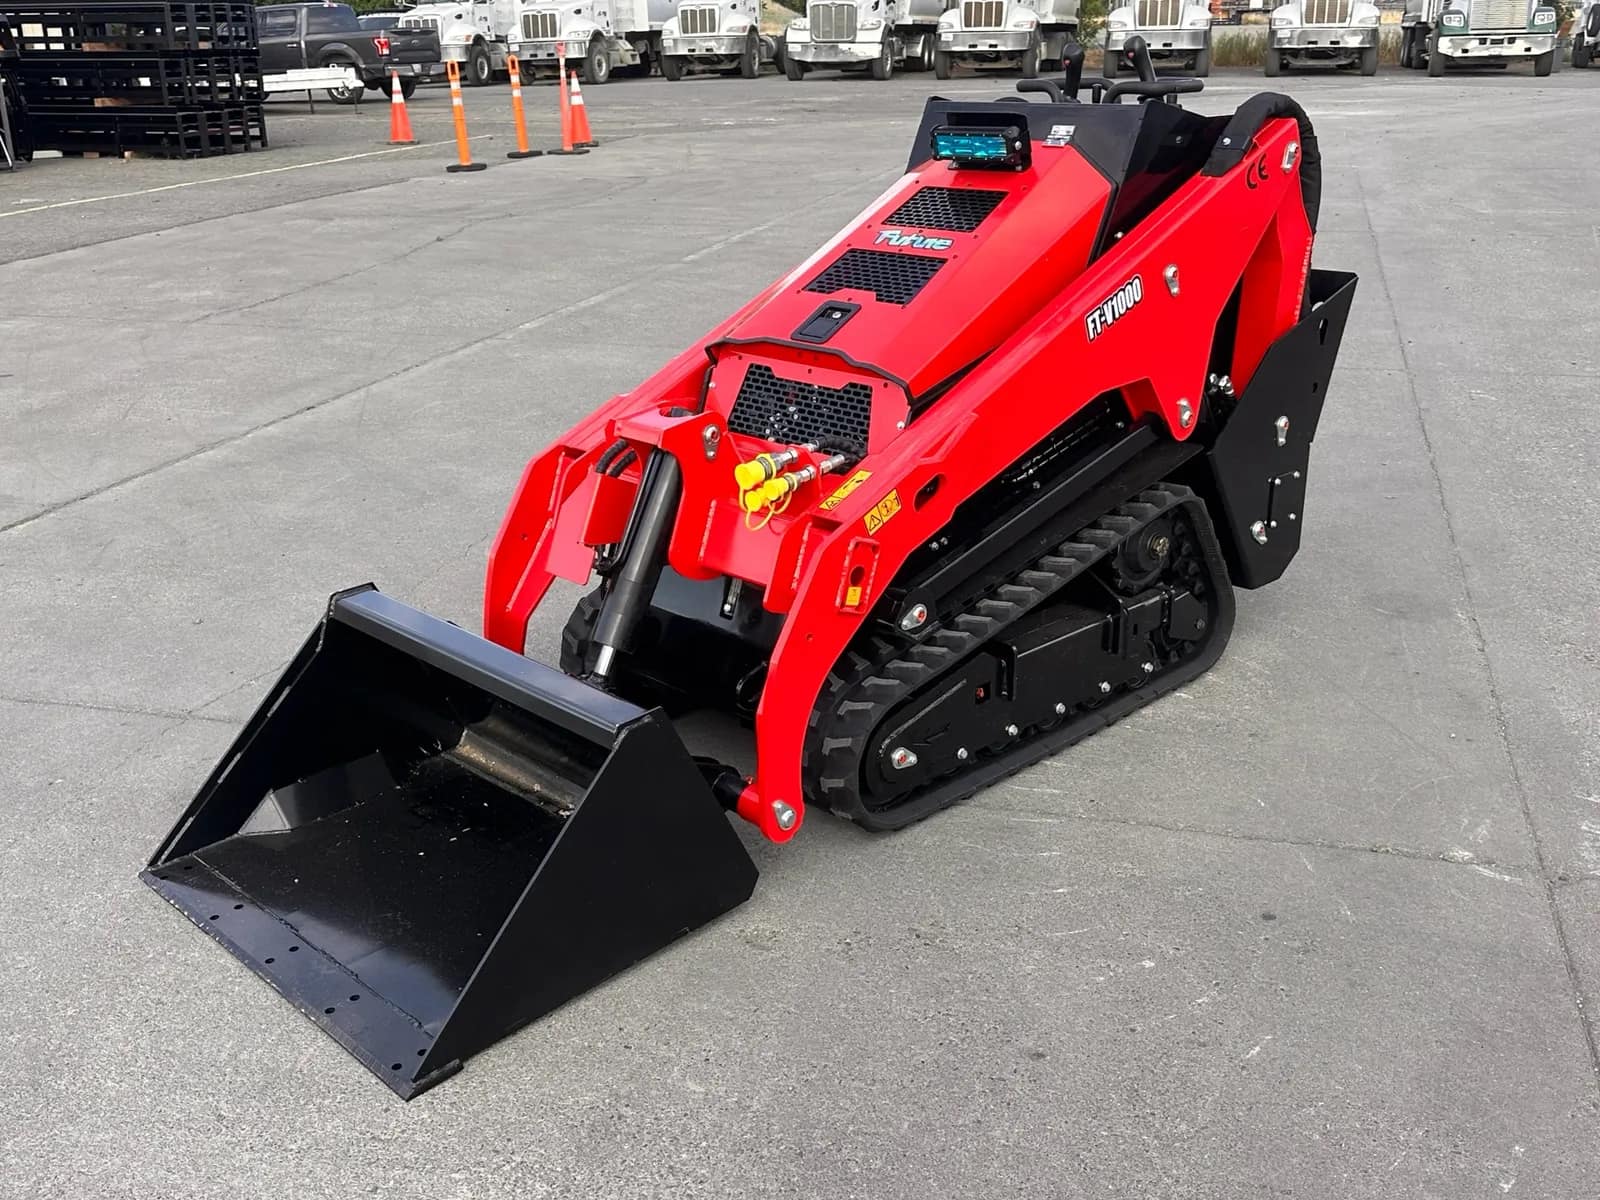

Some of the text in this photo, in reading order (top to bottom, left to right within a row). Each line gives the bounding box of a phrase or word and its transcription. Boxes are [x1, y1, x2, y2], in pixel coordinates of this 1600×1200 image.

[1247, 154, 1269, 189] CE
[874, 230, 953, 250] Future
[1086, 276, 1142, 340] FT-V1000
